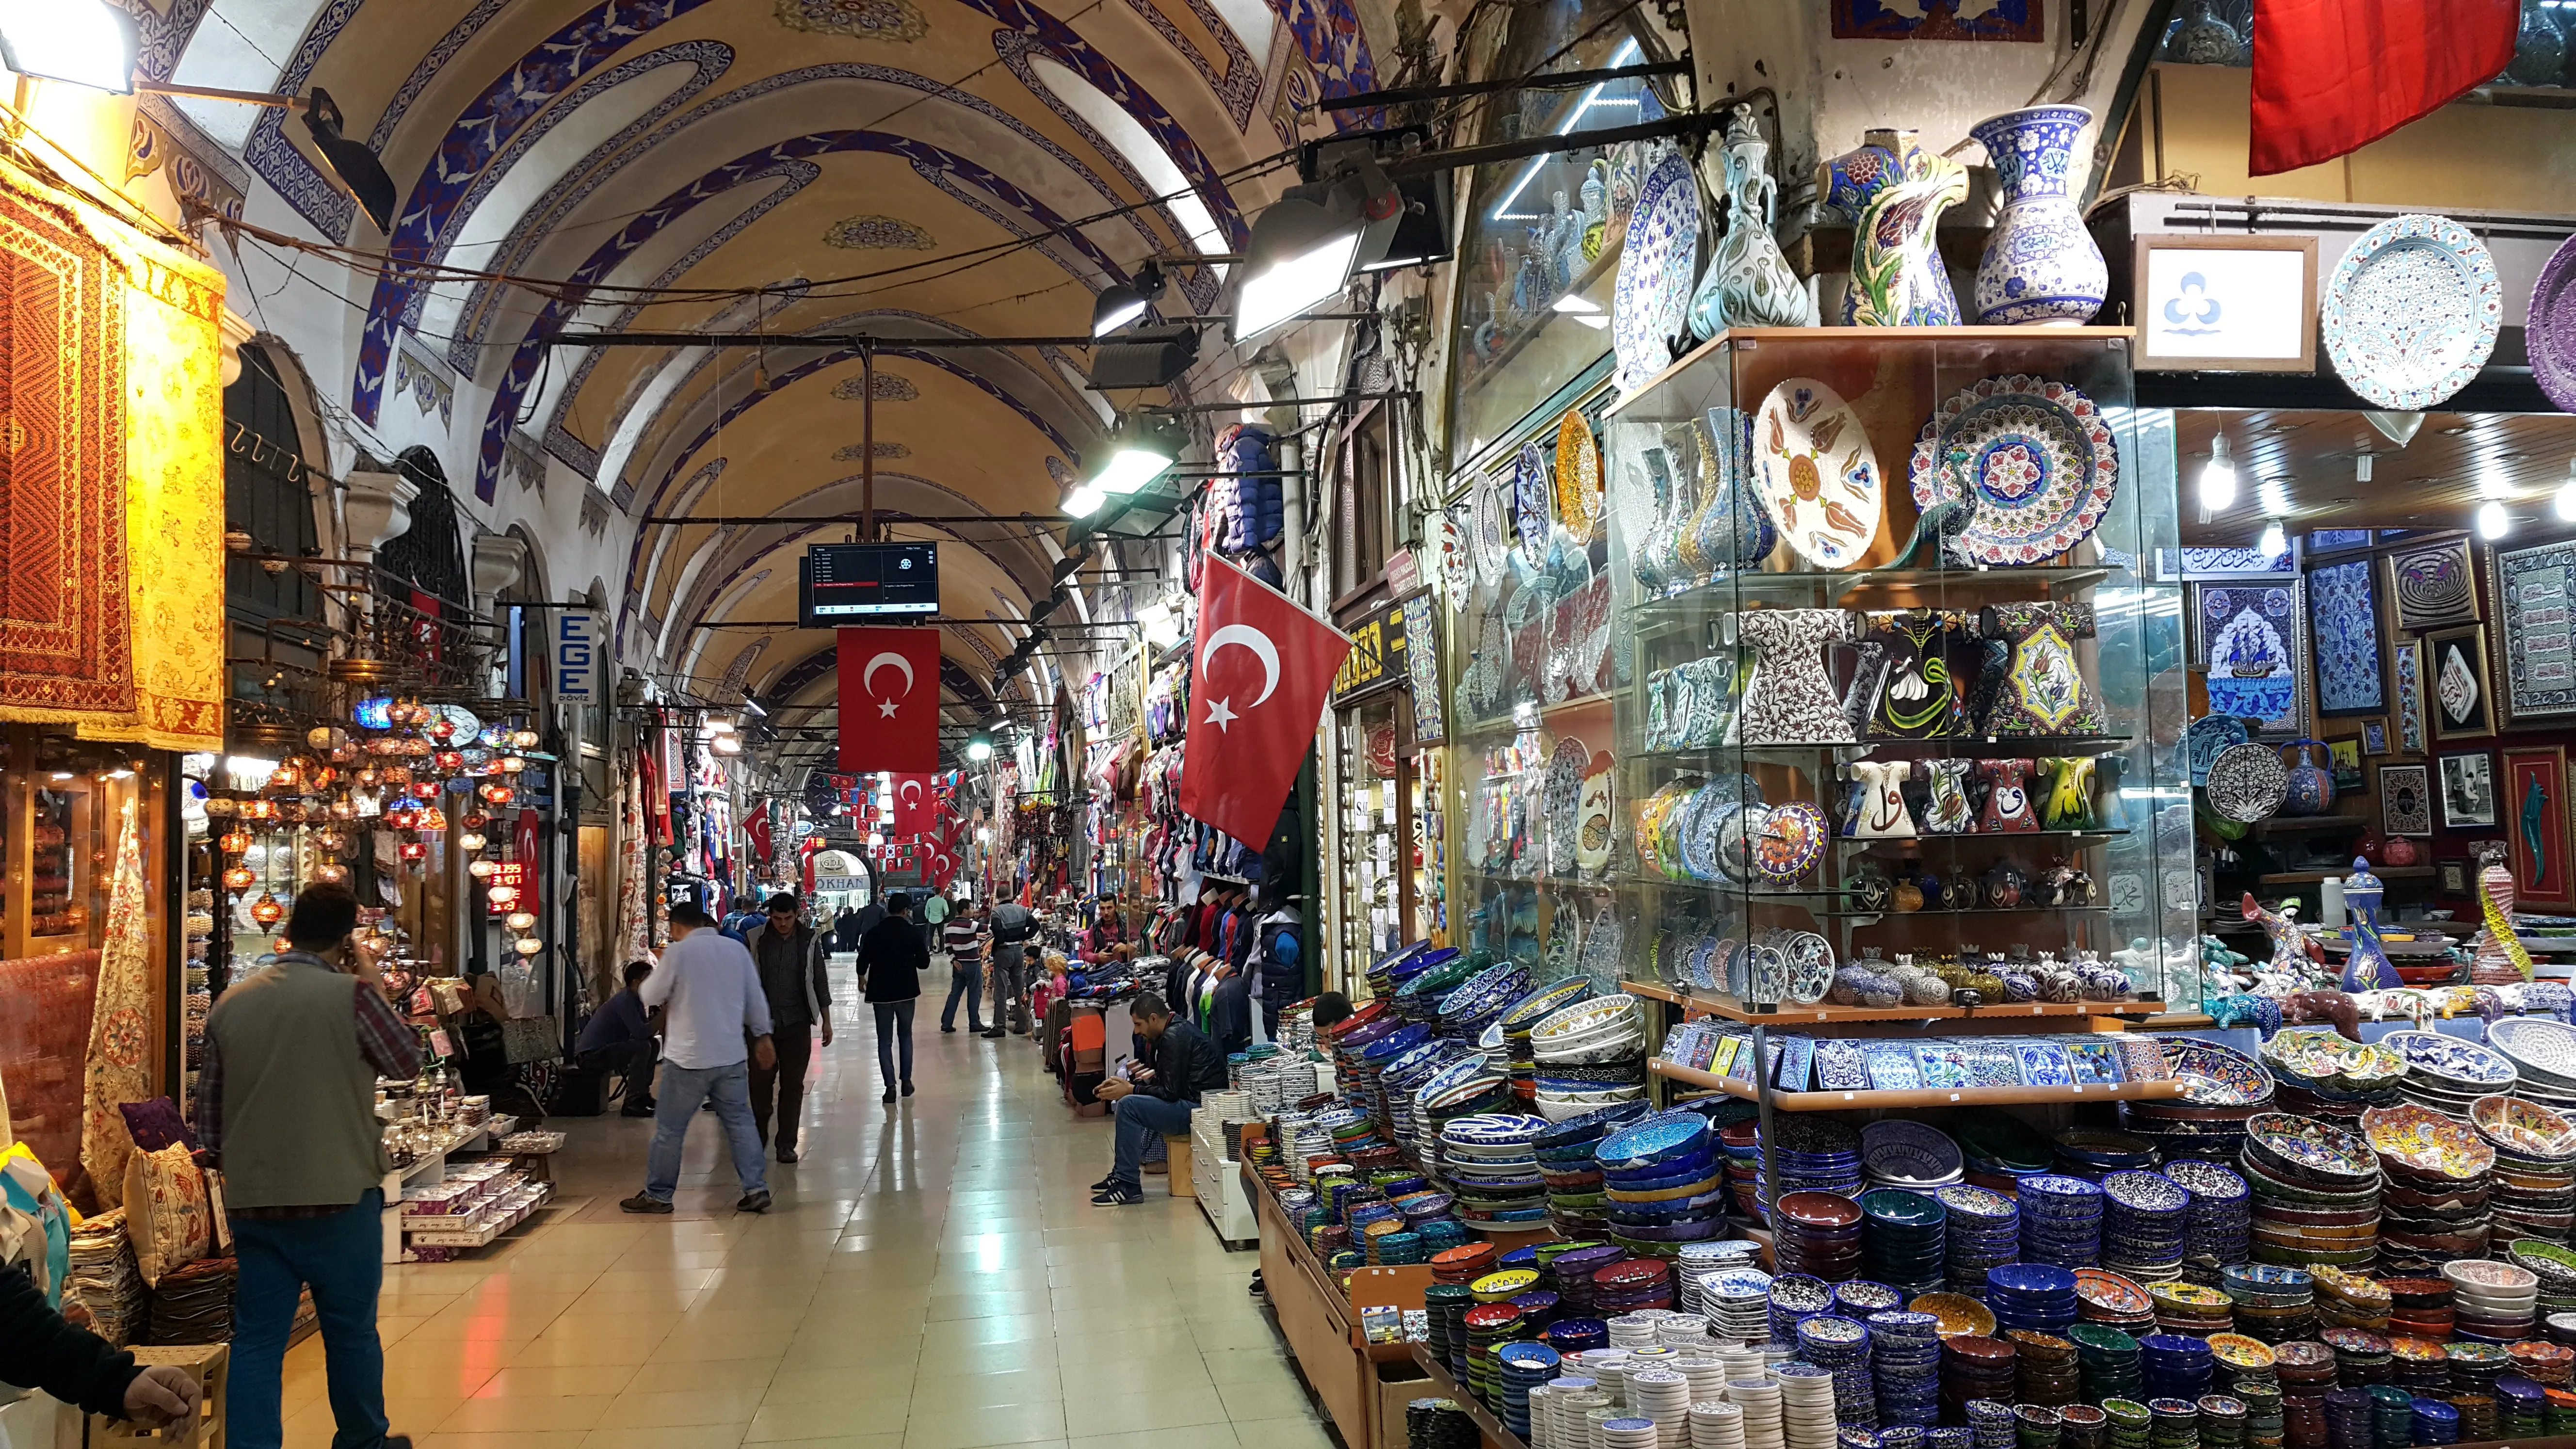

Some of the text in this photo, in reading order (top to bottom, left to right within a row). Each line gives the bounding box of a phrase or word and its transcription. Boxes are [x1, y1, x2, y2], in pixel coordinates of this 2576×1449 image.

[559, 616, 590, 693] EGE
[1384, 793, 1395, 808] SALE
[1356, 802, 1368, 816] SAL
[1377, 846, 1388, 862] SALE
[1802, 844, 1809, 855] 4
[1758, 851, 1764, 861] 8
[1768, 860, 1773, 869] 7
[1779, 862, 1786, 872] 6
[1792, 858, 1799, 868] 5
[816, 878, 863, 889] ÖKHAN
